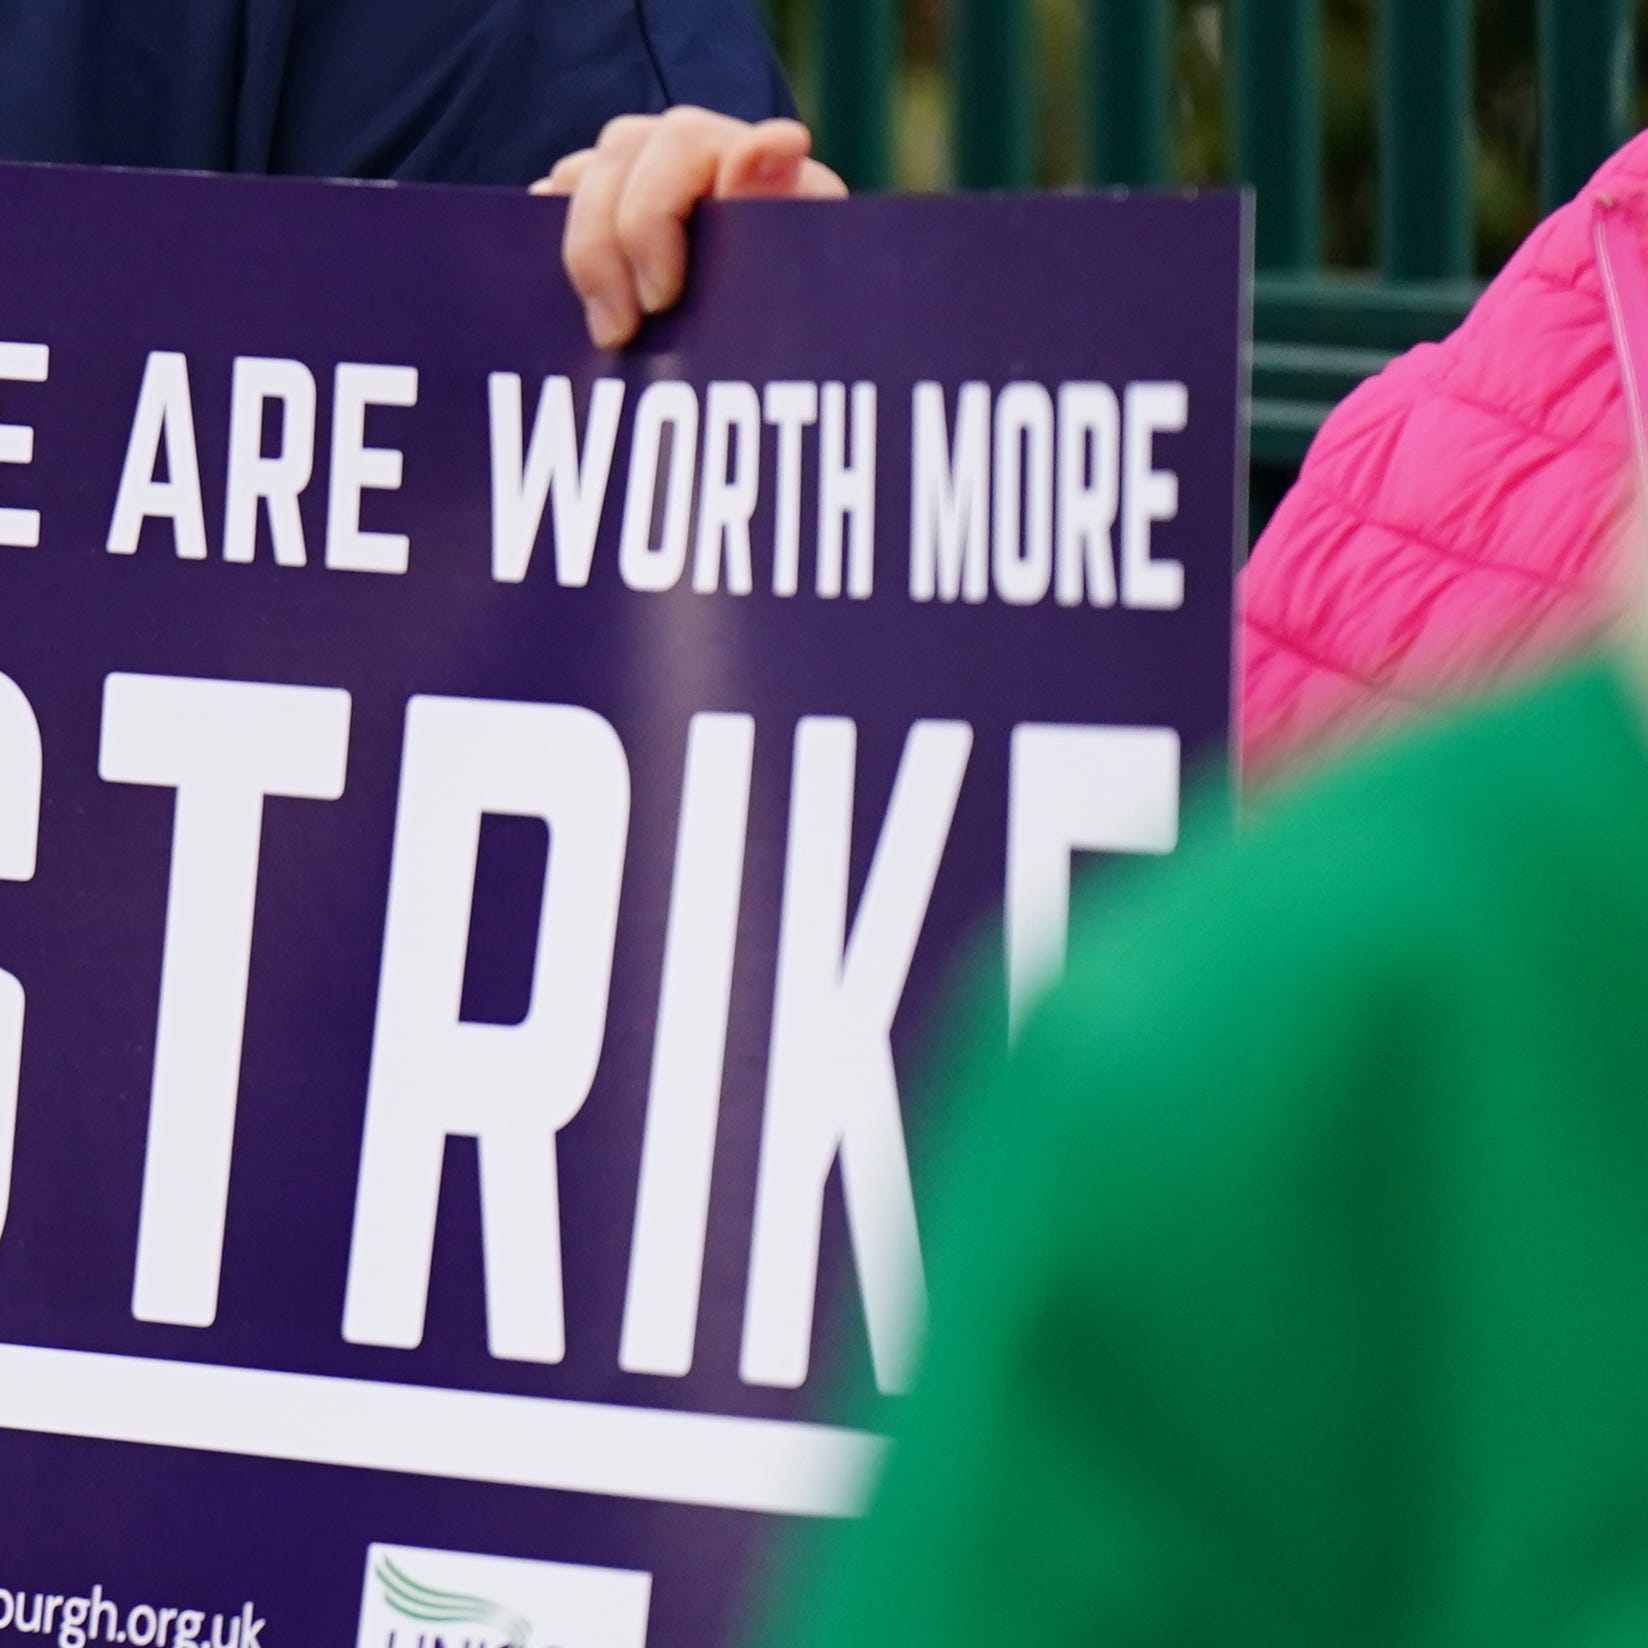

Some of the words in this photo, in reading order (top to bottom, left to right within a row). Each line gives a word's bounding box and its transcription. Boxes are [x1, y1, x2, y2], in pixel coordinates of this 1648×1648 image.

[106, 350, 419, 574] ARE
[489, 372, 877, 600] WORTH
[908, 381, 1189, 609] MORE
